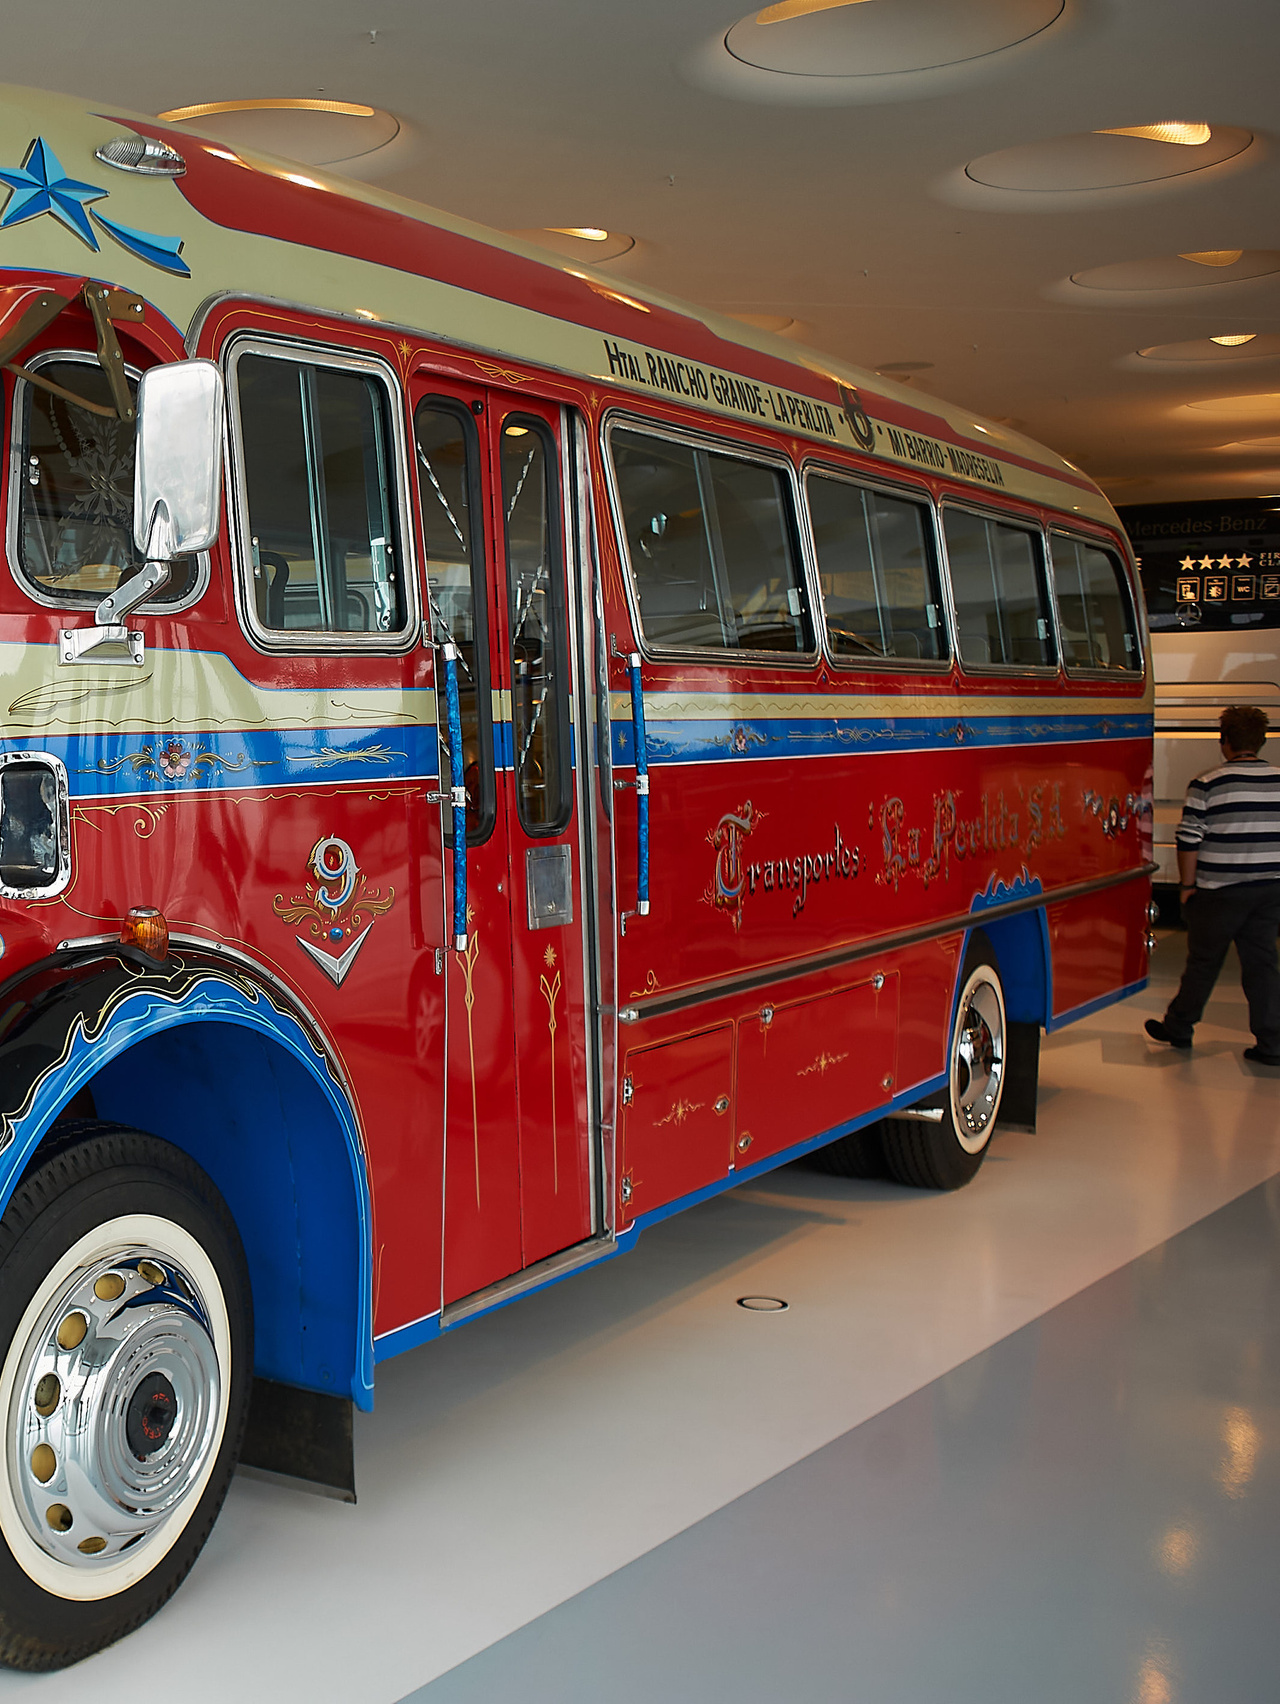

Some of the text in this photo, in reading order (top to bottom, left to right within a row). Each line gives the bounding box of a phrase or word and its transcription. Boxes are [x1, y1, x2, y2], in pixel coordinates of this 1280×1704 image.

[645, 351, 709, 401] RANCHO
[786, 395, 837, 437] PERLITA
[887, 427, 907, 458] MI
[1126, 516, 1268, 537] Mercedes-Benz
[310, 833, 361, 916] 9
